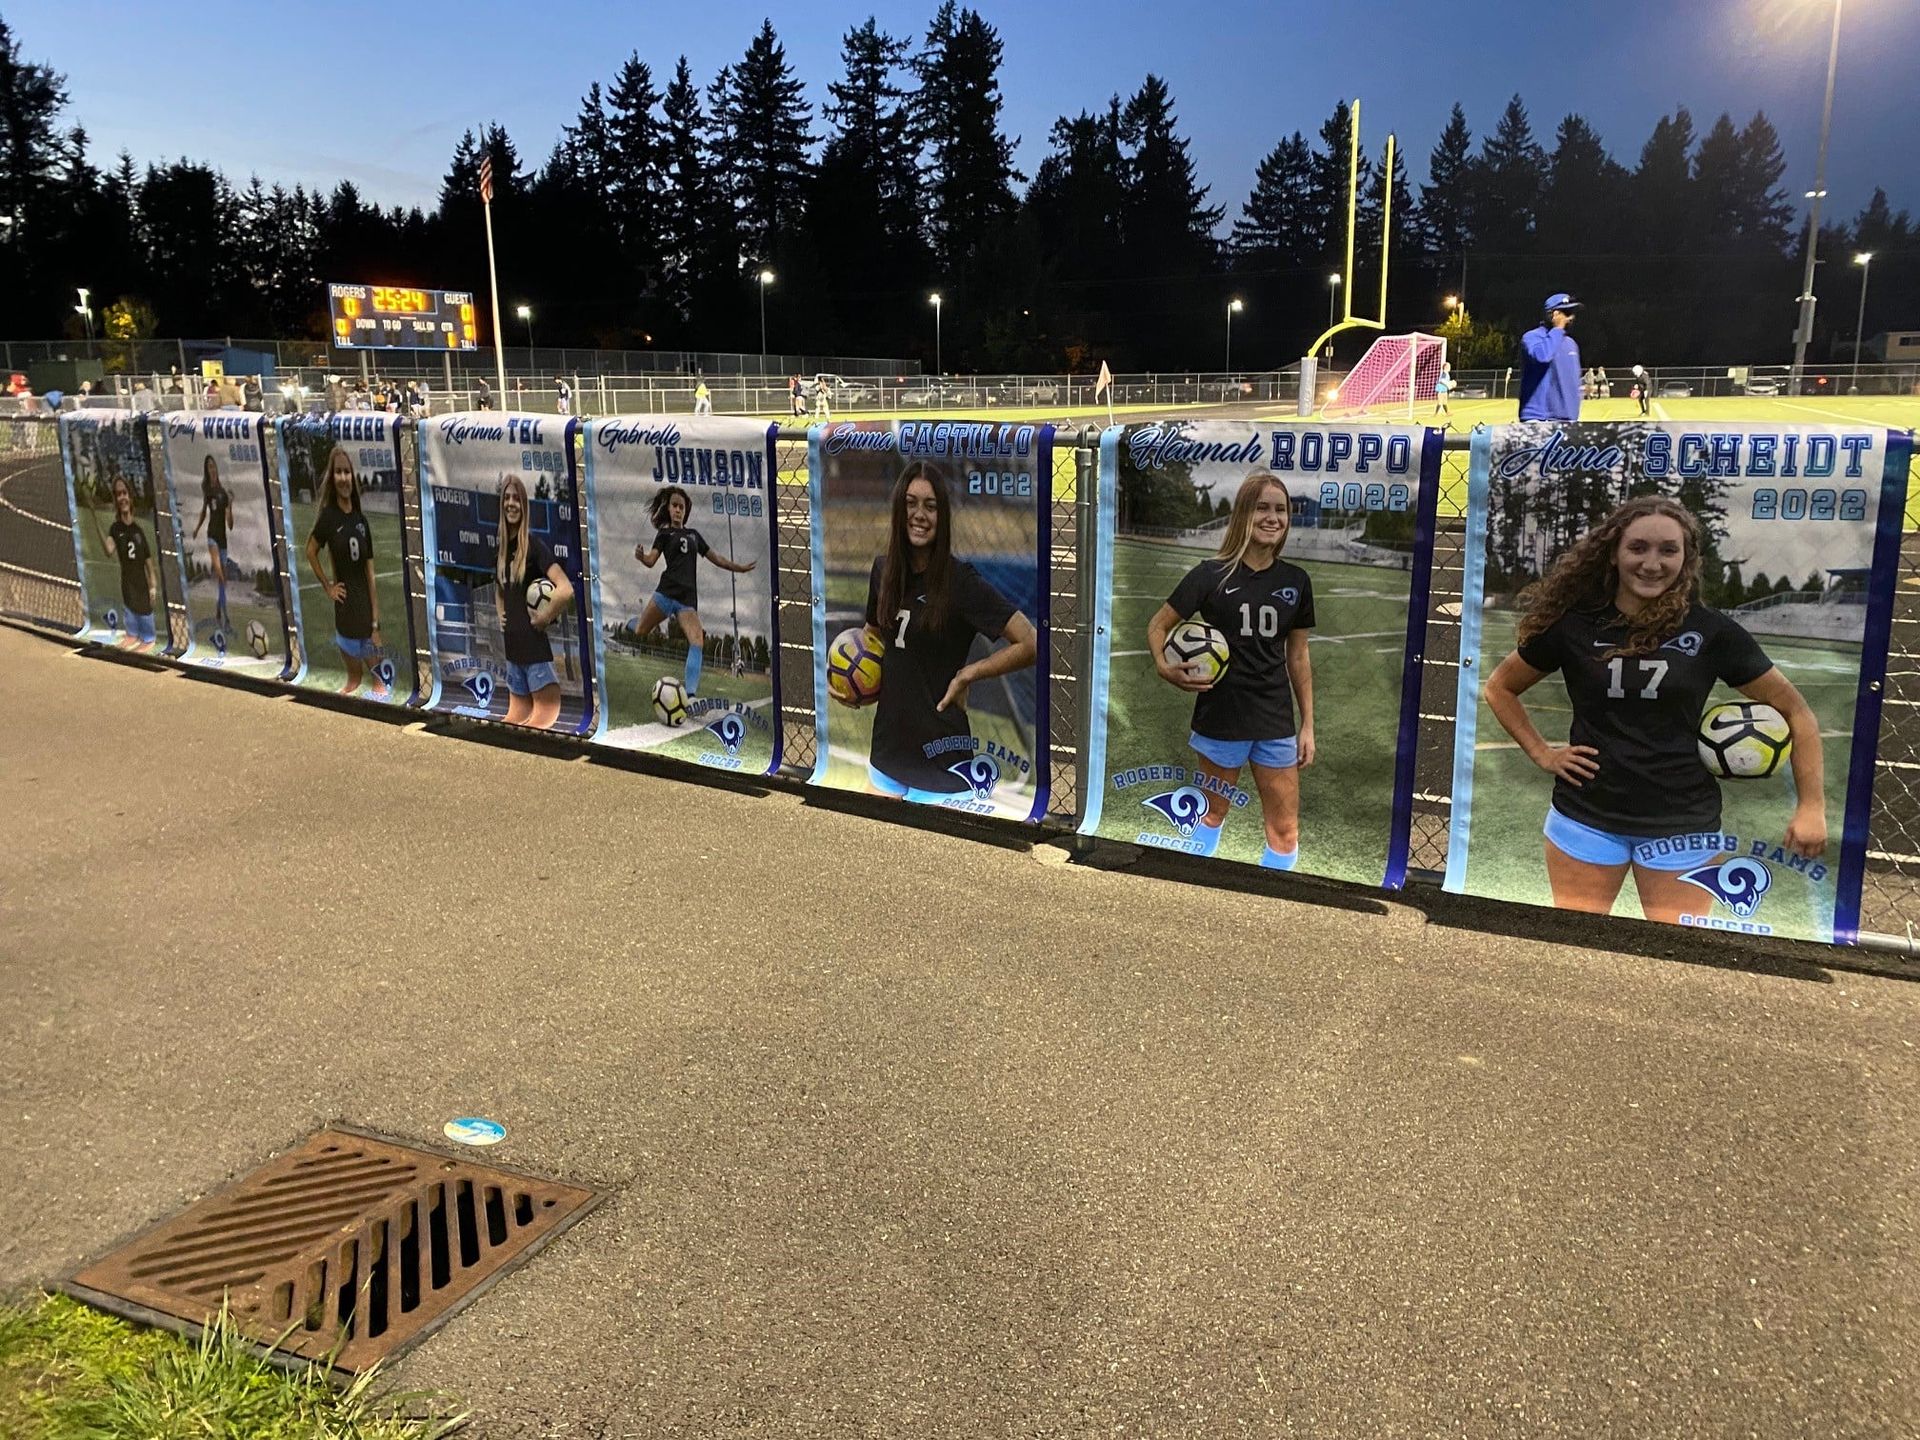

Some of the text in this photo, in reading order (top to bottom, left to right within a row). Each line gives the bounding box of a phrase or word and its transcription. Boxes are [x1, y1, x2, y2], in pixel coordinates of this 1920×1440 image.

[331, 285, 366, 299] ROGERS
[372, 287, 426, 311] 25:24
[444, 293, 469, 305] GUEST
[355, 318, 376, 330] DOWN
[382, 319, 401, 332] TO GO
[440, 417, 504, 446] Karinna
[598, 419, 682, 453] Gabrielle
[825, 422, 1034, 459] Emma CASTILLO
[521, 450, 565, 473] 2022
[1129, 425, 1412, 474] Hannah ROPPO
[1500, 429, 1874, 479] Anna SCHEIDT
[652, 446, 764, 489] JOHNSON
[968, 471, 1032, 496] 2022
[435, 487, 470, 507] ROGERS
[712, 492, 763, 517] 2022
[1319, 481, 1410, 512] 2022
[1751, 487, 1868, 521] 2022
[127, 541, 136, 559] 2
[349, 536, 360, 561] 8
[459, 530, 480, 545] DOWN
[679, 537, 689, 554] 3
[553, 544, 569, 558] QTR
[894, 609, 911, 649] 7
[1238, 602, 1279, 639] 10
[1606, 656, 1670, 700] 17
[922, 735, 1031, 774] ROGERS RAMS
[1111, 764, 1251, 809] ROGERS RAMS
[942, 797, 996, 815] SOCCER
[1137, 832, 1206, 852] SOCCER
[1634, 832, 1828, 882] ROGERS RAMS
[1679, 914, 1773, 936] SOCCER
